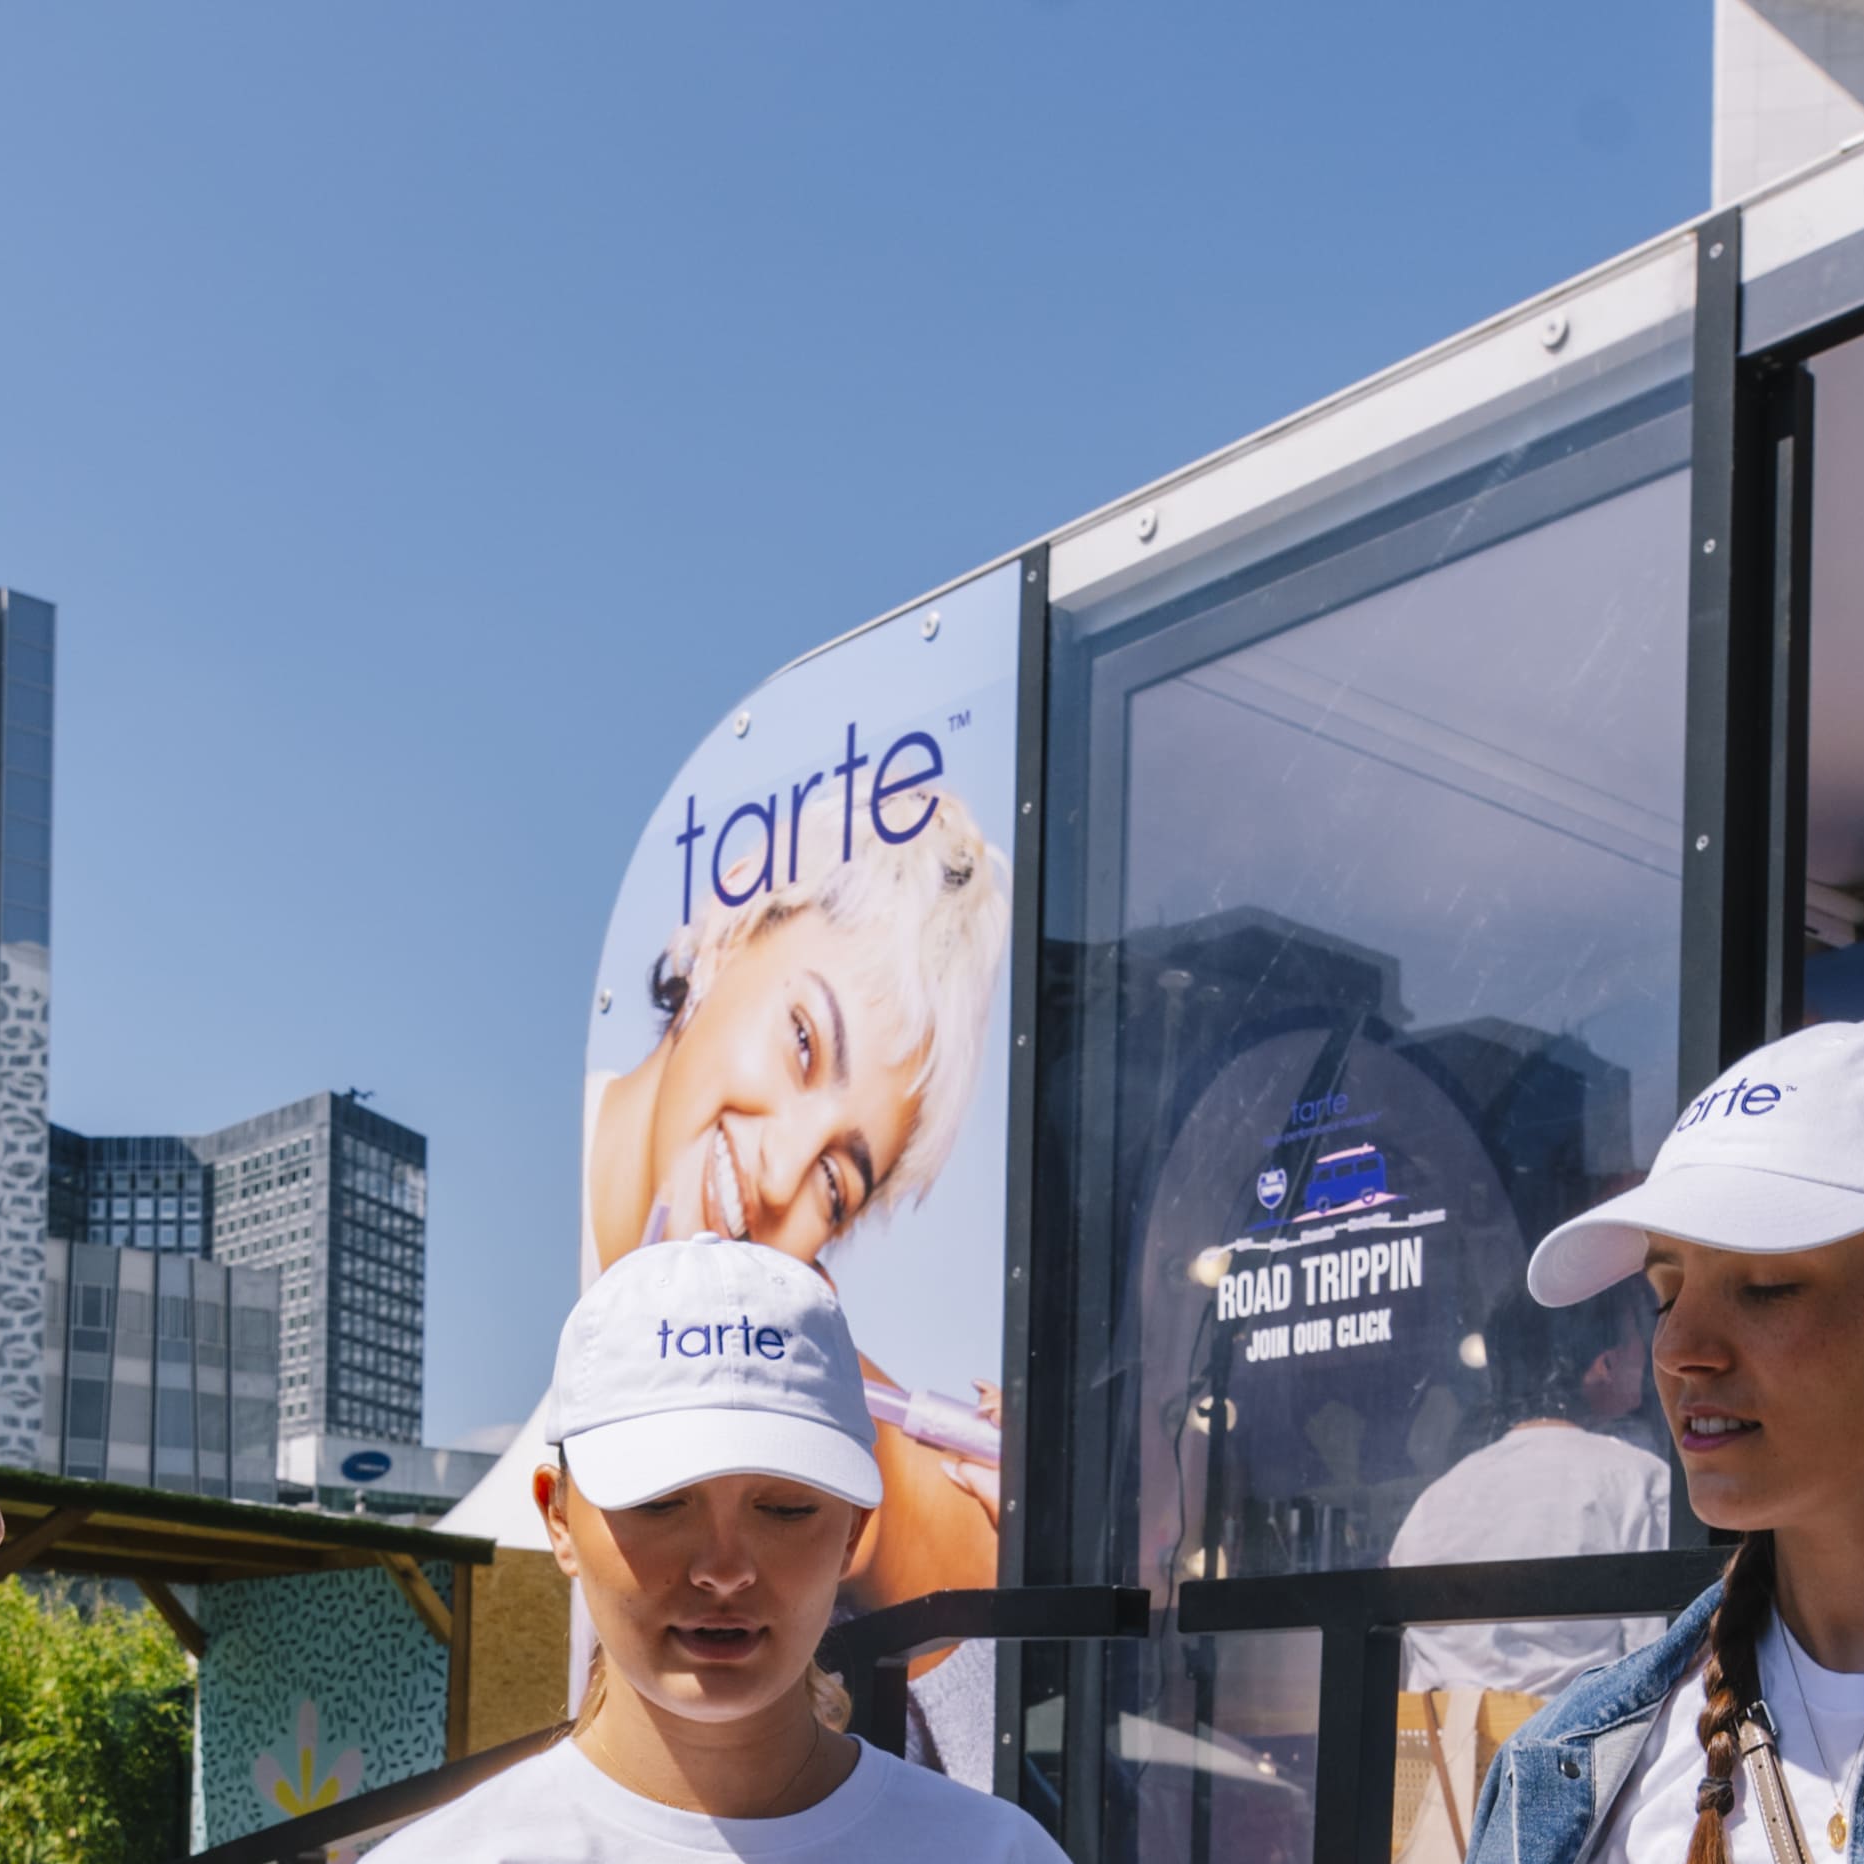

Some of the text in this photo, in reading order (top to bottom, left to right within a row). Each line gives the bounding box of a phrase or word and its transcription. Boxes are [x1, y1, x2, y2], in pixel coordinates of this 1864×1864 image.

[1291, 1090, 1349, 1124] tarte
[1217, 1236, 1423, 1321] ROAD TRIPPIN
[1245, 1307, 1392, 1362] JOIN OUR CLICK
